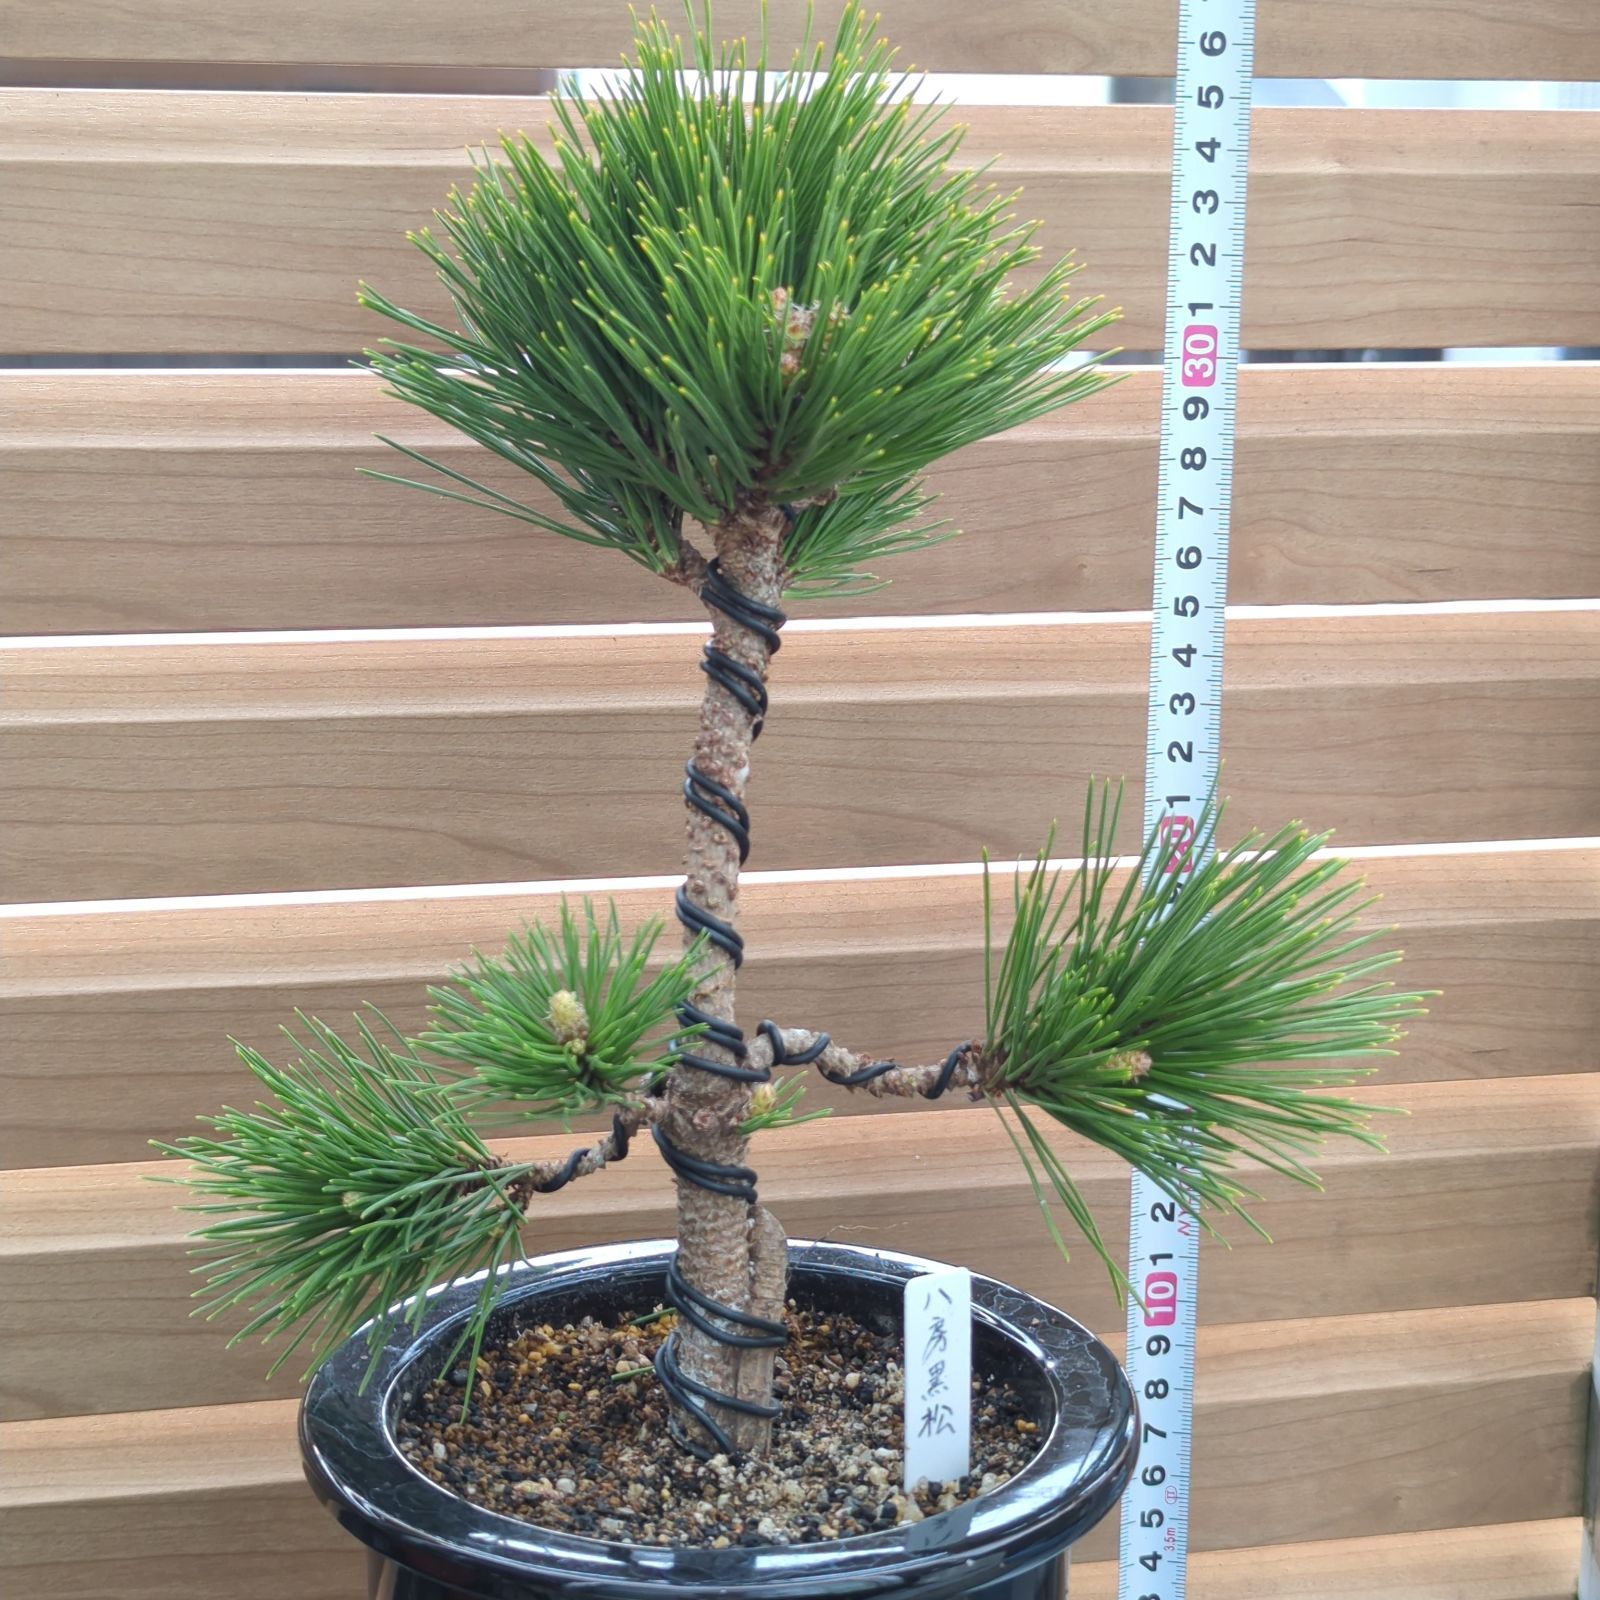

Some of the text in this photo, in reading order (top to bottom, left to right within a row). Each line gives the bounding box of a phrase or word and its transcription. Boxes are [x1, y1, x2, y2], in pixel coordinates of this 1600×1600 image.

[1199, 30, 1227, 57] 6
[1197, 85, 1224, 109] 5
[1195, 137, 1221, 163] 4
[1192, 189, 1219, 215] 3
[1190, 242, 1216, 267] 2
[1188, 302, 1213, 317] 1
[1184, 333, 1215, 379] 30
[1183, 396, 1209, 421] 9
[1180, 446, 1207, 471] 8
[1178, 496, 1204, 520] 7
[1175, 546, 1202, 570] 6
[1174, 595, 1200, 618] 5
[1172, 643, 1197, 668] 4
[1169, 692, 1196, 716] 3
[1167, 741, 1193, 763] 2
[1165, 795, 1191, 809] 1
[1150, 1201, 1176, 1223] 2
[1149, 1253, 1174, 1266] 1
[1146, 1280, 1175, 1319] 10
[1146, 1334, 1171, 1357] 9
[1144, 1378, 1170, 1400] 8
[1143, 1422, 1167, 1444] 7
[1141, 1464, 1166, 1487] 6
[1140, 1508, 1165, 1529] 5
[1163, 1527, 1176, 1552] 3.5m
[1139, 1550, 1163, 1572] 4
